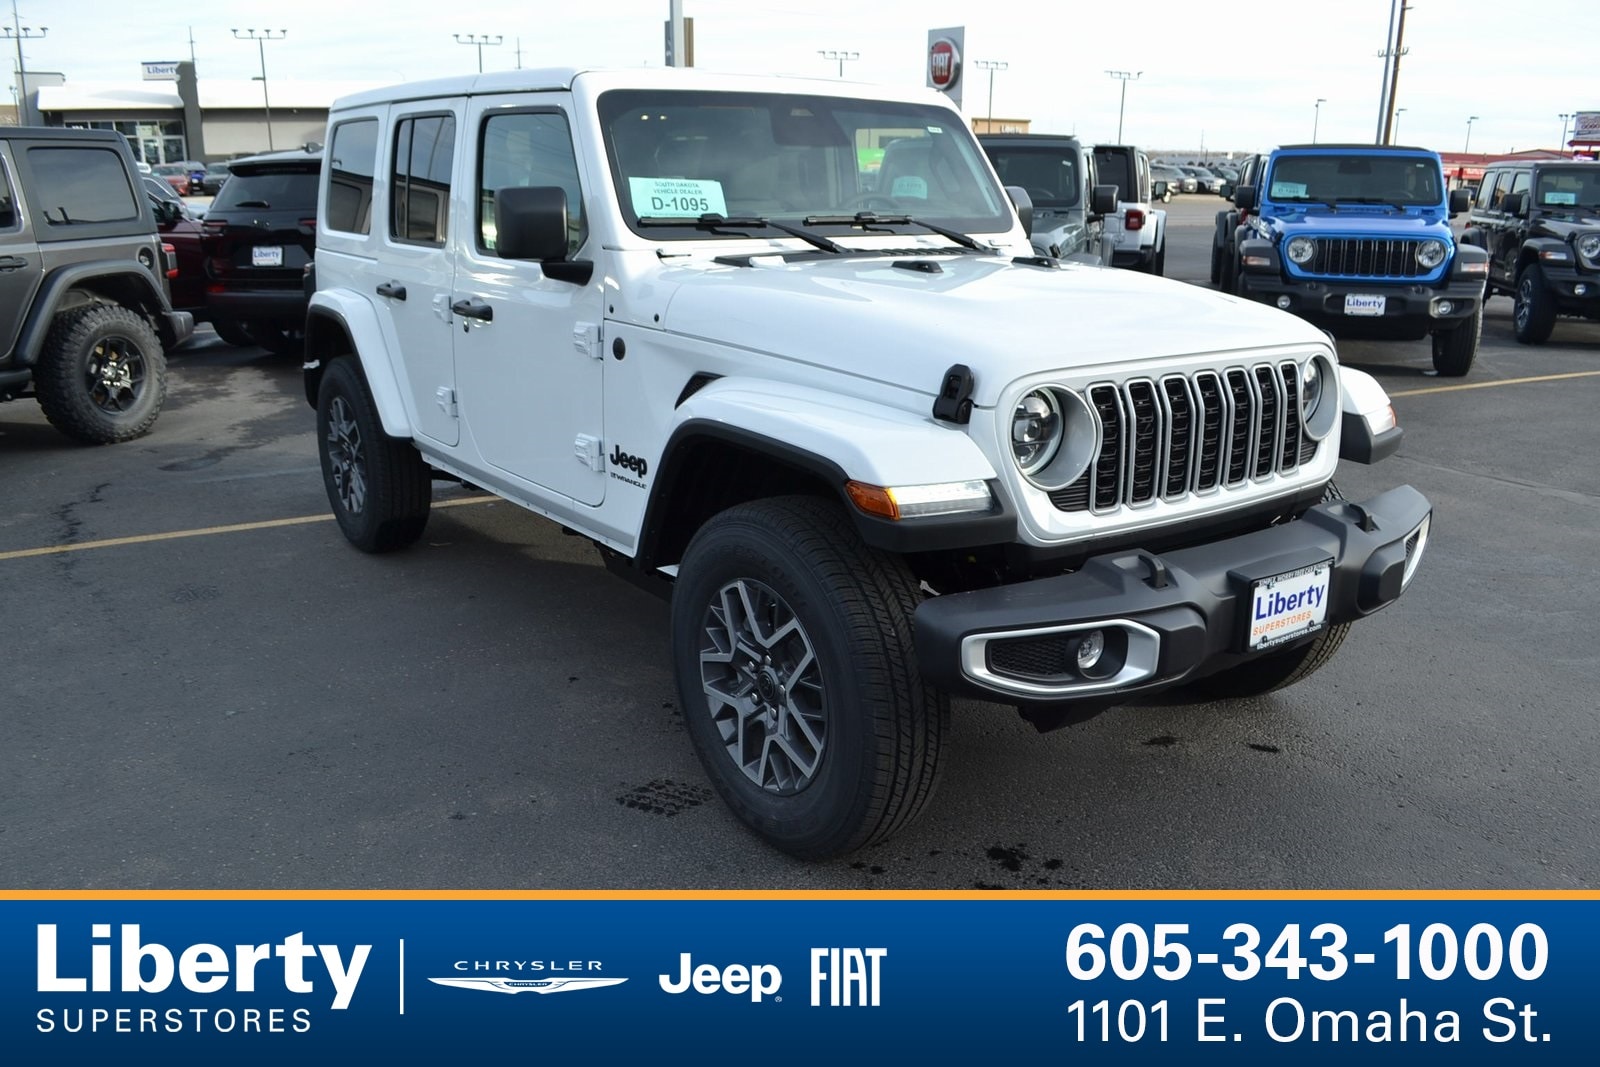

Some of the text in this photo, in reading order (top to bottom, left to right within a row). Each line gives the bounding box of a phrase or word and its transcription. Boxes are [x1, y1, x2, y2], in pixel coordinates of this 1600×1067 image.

[651, 196, 709, 212] D-1095
[1347, 298, 1382, 308] Liberty
[610, 444, 648, 479] Jeep
[1256, 584, 1325, 620] Liberty
[1253, 610, 1312, 636] SUPERSTORES
[1257, 624, 1322, 650] libertysuperstores.com
